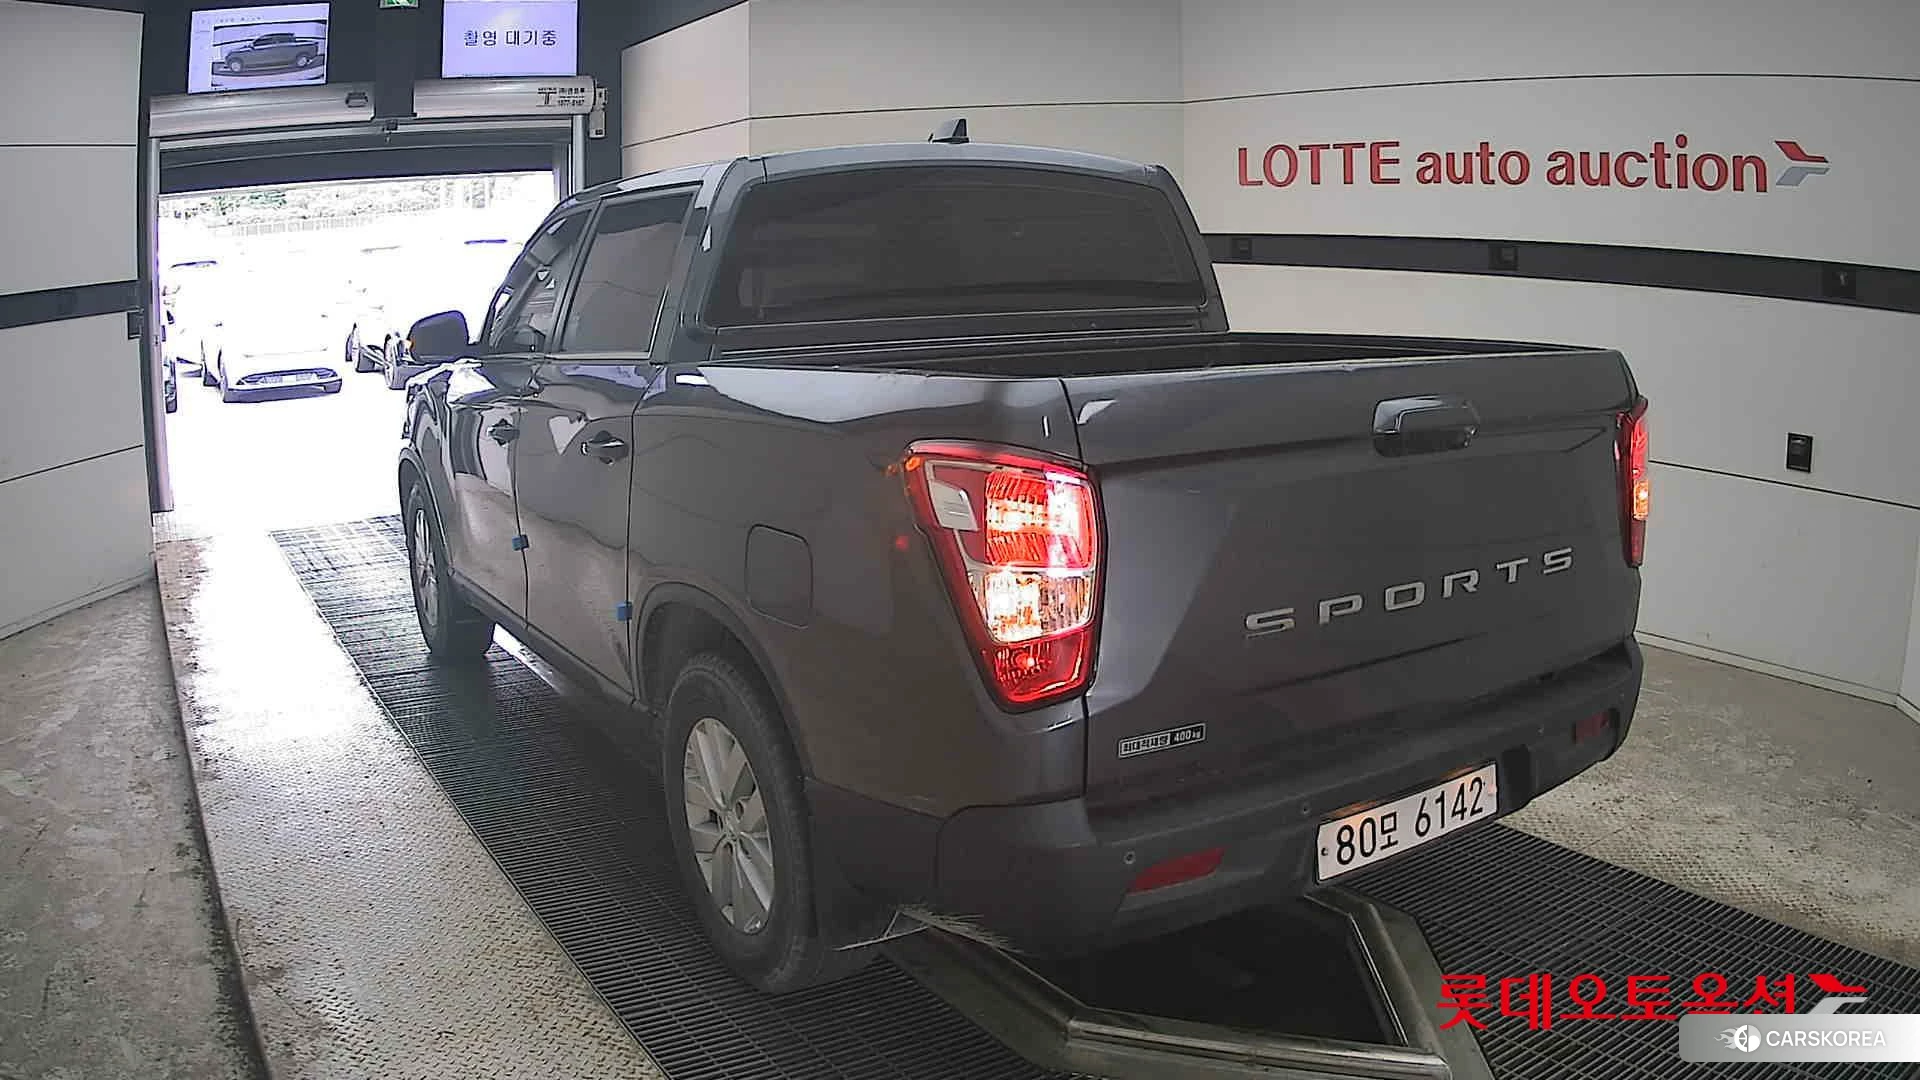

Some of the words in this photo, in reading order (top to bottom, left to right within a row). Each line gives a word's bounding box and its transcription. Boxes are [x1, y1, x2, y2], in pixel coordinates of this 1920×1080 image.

[505, 29, 558, 47] 대기중
[1238, 141, 1400, 187] LOTTE
[1416, 142, 1530, 187] auto
[1546, 134, 1767, 193] auction
[1245, 547, 1573, 638] SPORTS
[1336, 811, 1399, 865] 80모
[1415, 776, 1484, 837] 6142
